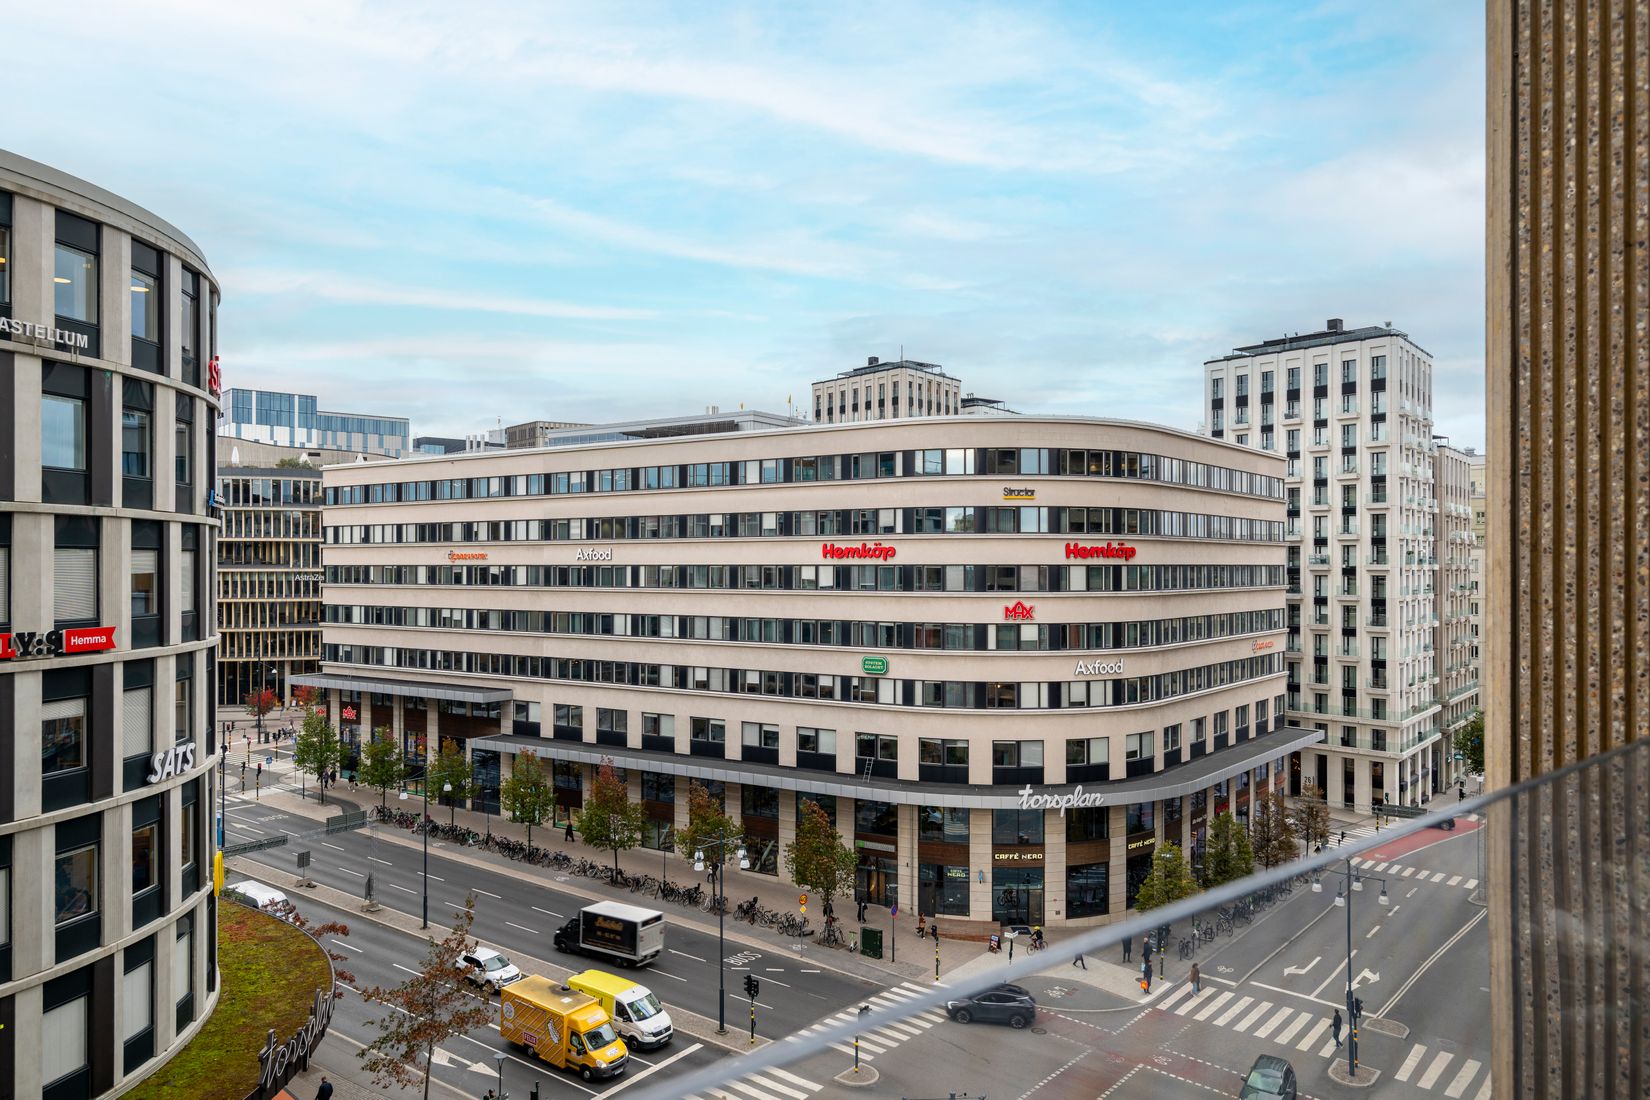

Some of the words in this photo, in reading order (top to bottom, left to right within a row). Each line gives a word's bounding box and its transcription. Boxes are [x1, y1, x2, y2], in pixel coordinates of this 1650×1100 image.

[1002, 487, 1036, 496] Structor
[576, 548, 612, 561] Axfood
[822, 542, 896, 561] Hemköp
[1065, 542, 1137, 561] Hemköp
[1004, 600, 1034, 620] MAX
[71, 635, 107, 646] Hemma
[1075, 657, 1124, 675] Axfood
[147, 742, 196, 783] SATS
[1018, 784, 1104, 818] torsplan
[723, 950, 763, 966] BUSS
